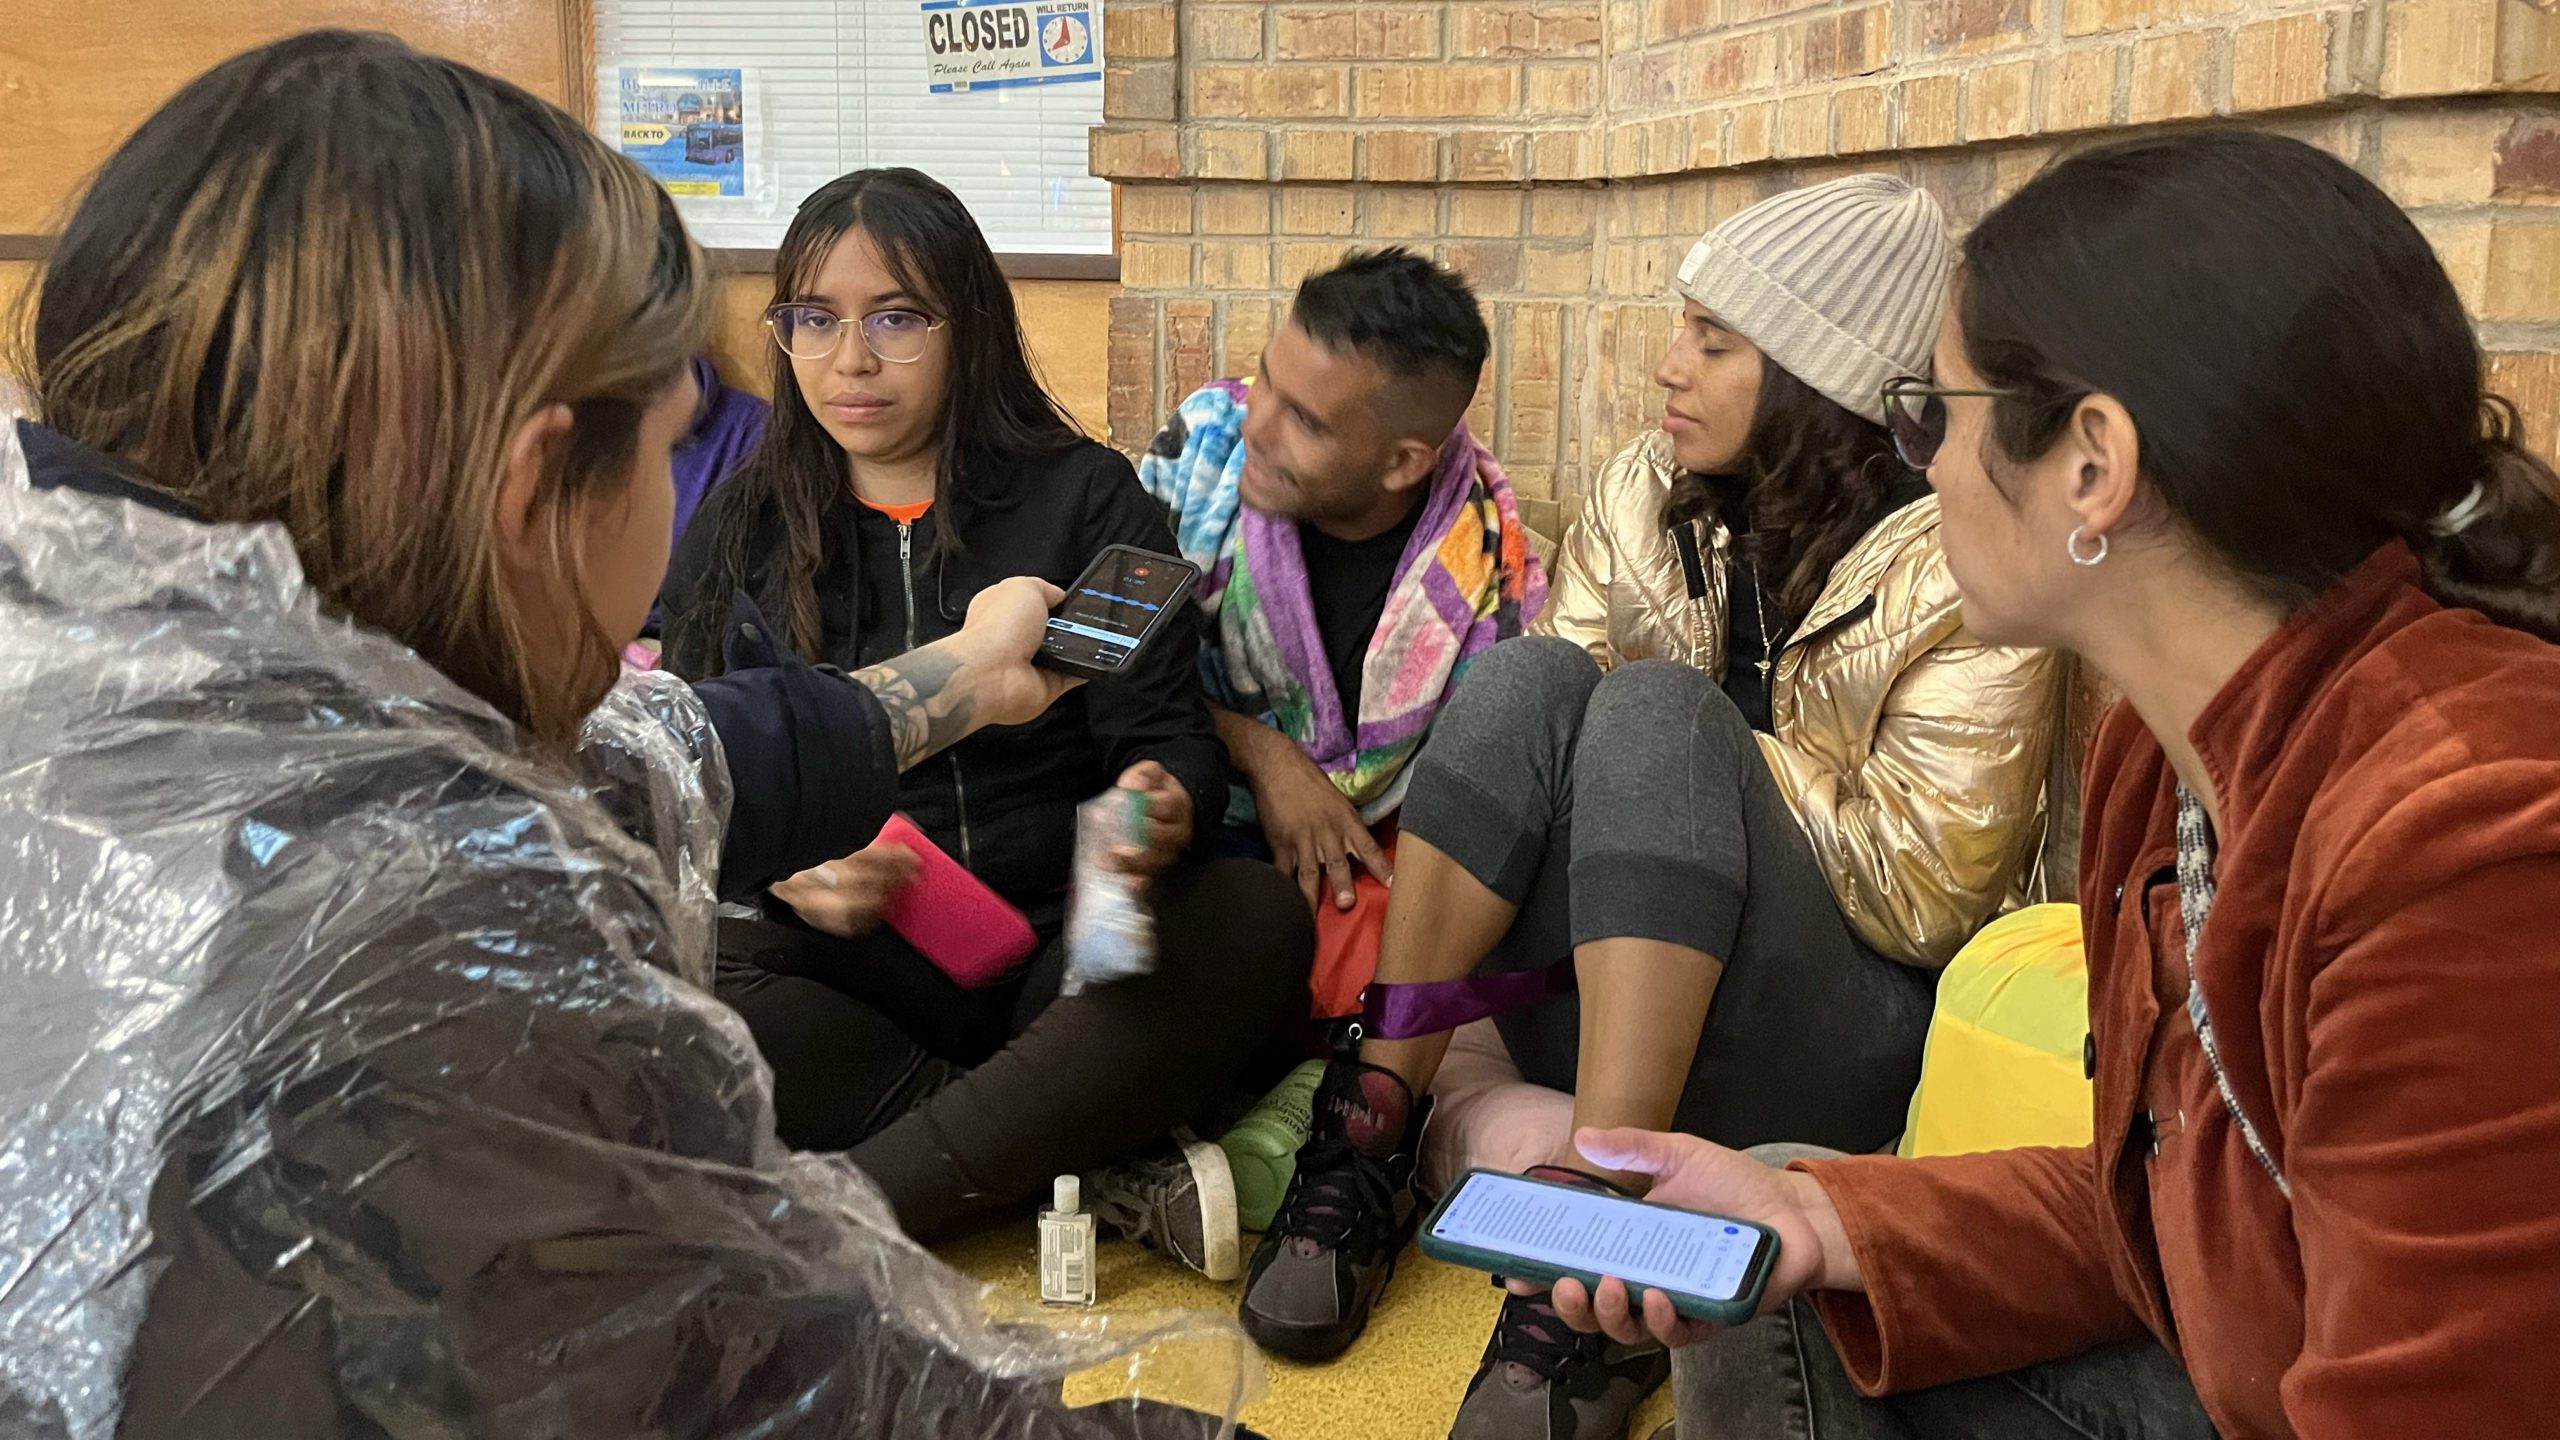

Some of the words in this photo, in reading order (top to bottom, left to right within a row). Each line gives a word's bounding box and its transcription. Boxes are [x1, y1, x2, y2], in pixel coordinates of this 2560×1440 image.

[1036, 5, 1056, 14] WILL
[1057, 2, 1089, 12] RETURN
[929, 7, 1030, 55] CLOSED
[934, 63, 968, 76] Please
[972, 60, 995, 74] Call
[998, 58, 1031, 72] Again
[623, 101, 678, 113] METRO
[623, 130, 650, 139] BACK
[651, 130, 664, 139] TO
